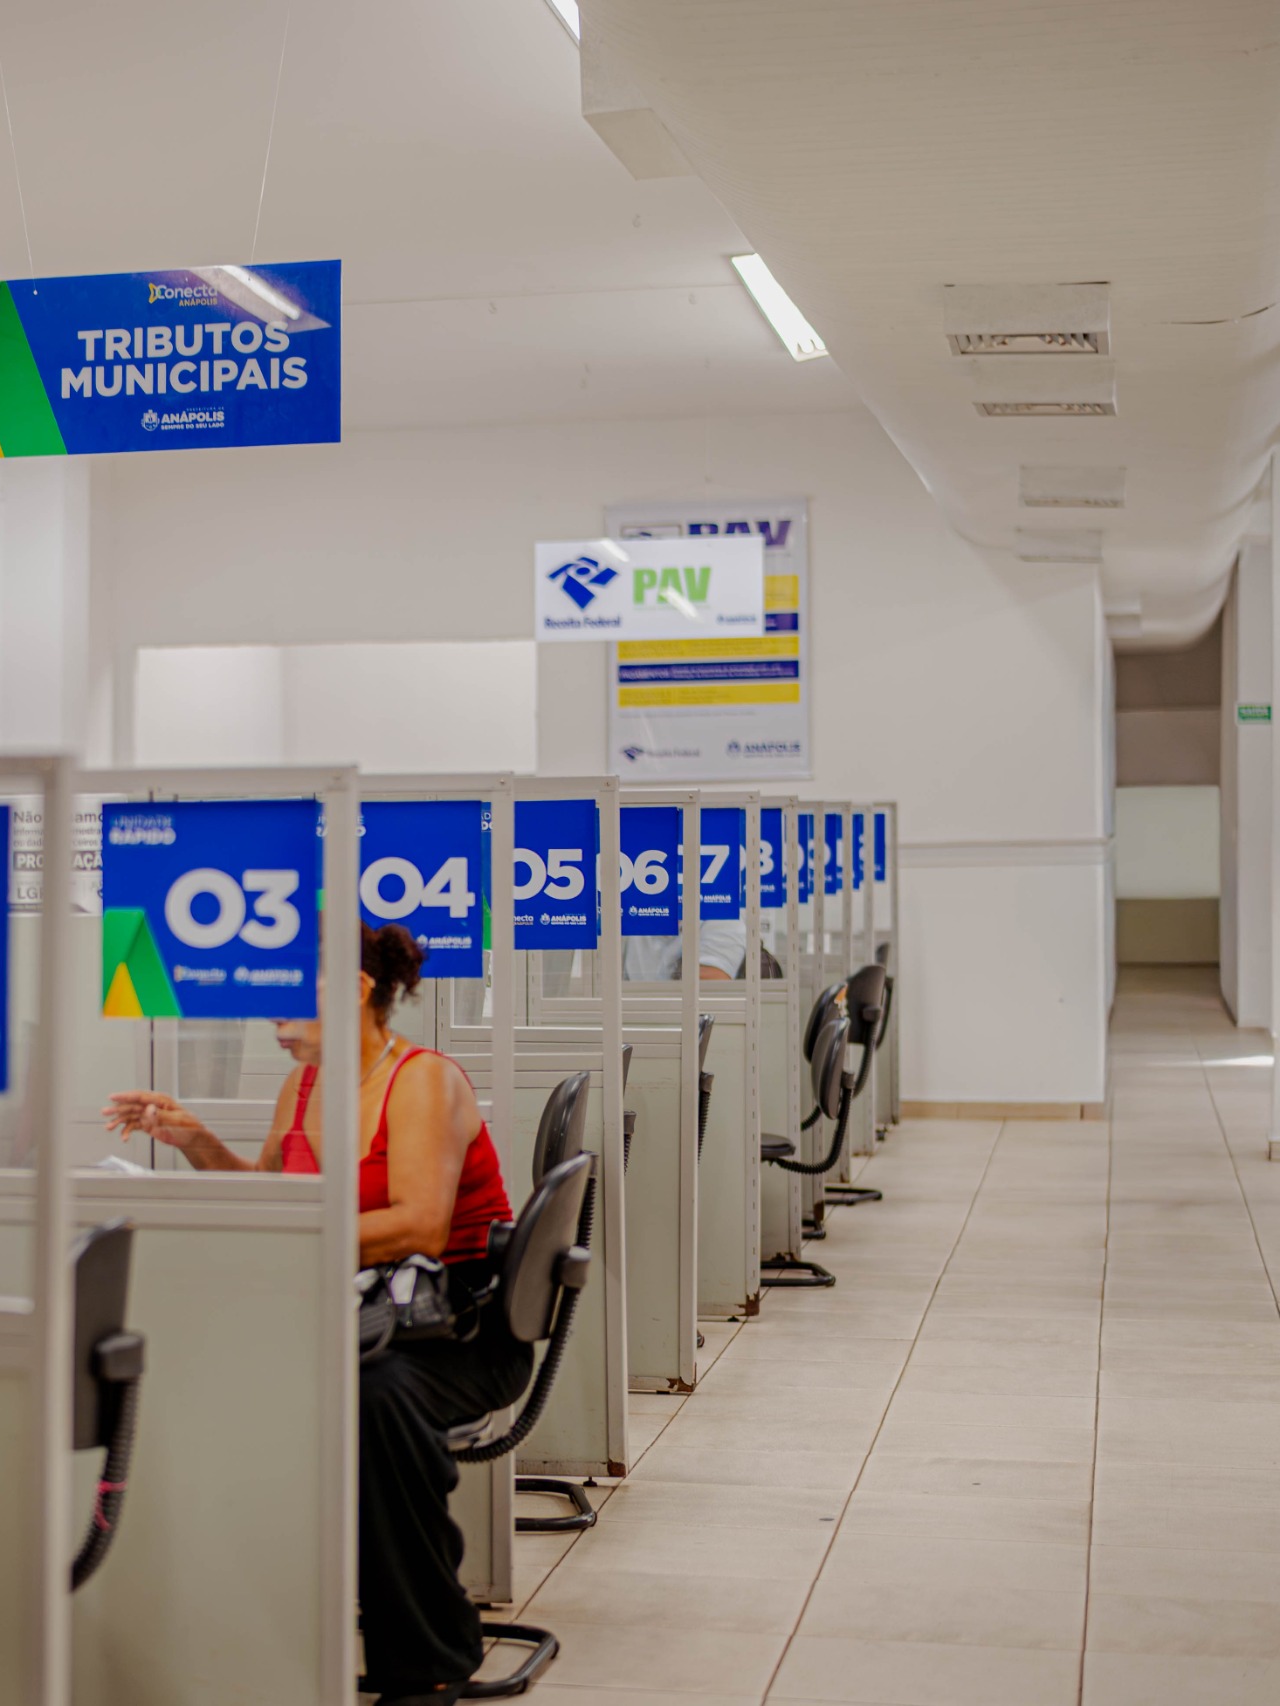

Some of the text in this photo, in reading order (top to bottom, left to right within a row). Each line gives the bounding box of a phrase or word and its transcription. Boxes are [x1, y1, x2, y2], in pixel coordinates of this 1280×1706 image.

[156, 284, 218, 300] Conecta
[77, 321, 290, 361] TRIBUTOS
[61, 357, 308, 399] MUNICIPAIS
[161, 411, 225, 424] ANÁPOLIS
[633, 566, 711, 605] PAV
[13, 811, 42, 824] Não
[360, 857, 475, 919] 04
[513, 848, 584, 900] 05
[164, 867, 300, 949] 03
